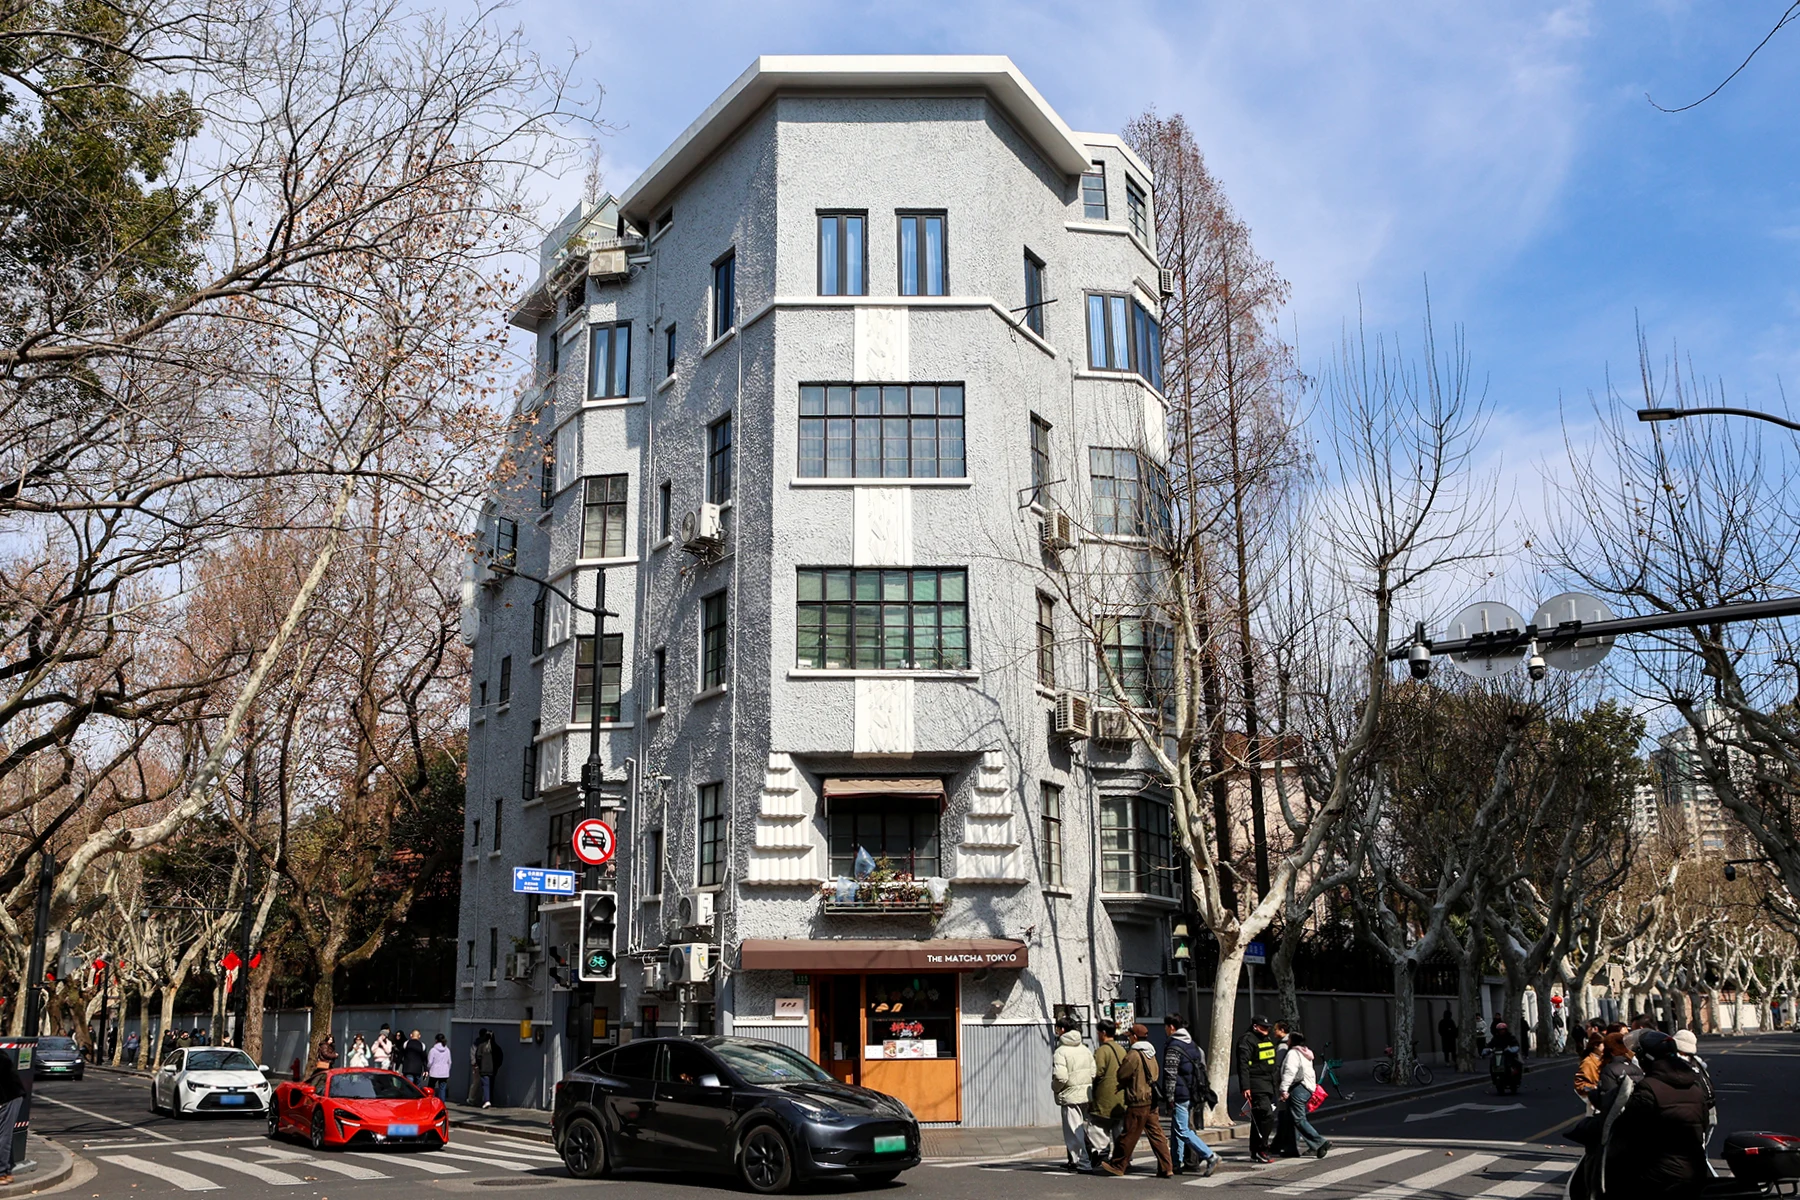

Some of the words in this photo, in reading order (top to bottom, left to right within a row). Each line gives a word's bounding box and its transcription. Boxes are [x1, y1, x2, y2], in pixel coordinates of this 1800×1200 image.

[927, 954, 943, 963] THE
[945, 954, 983, 962] MATCHA
[985, 953, 1017, 962] TOKYO
